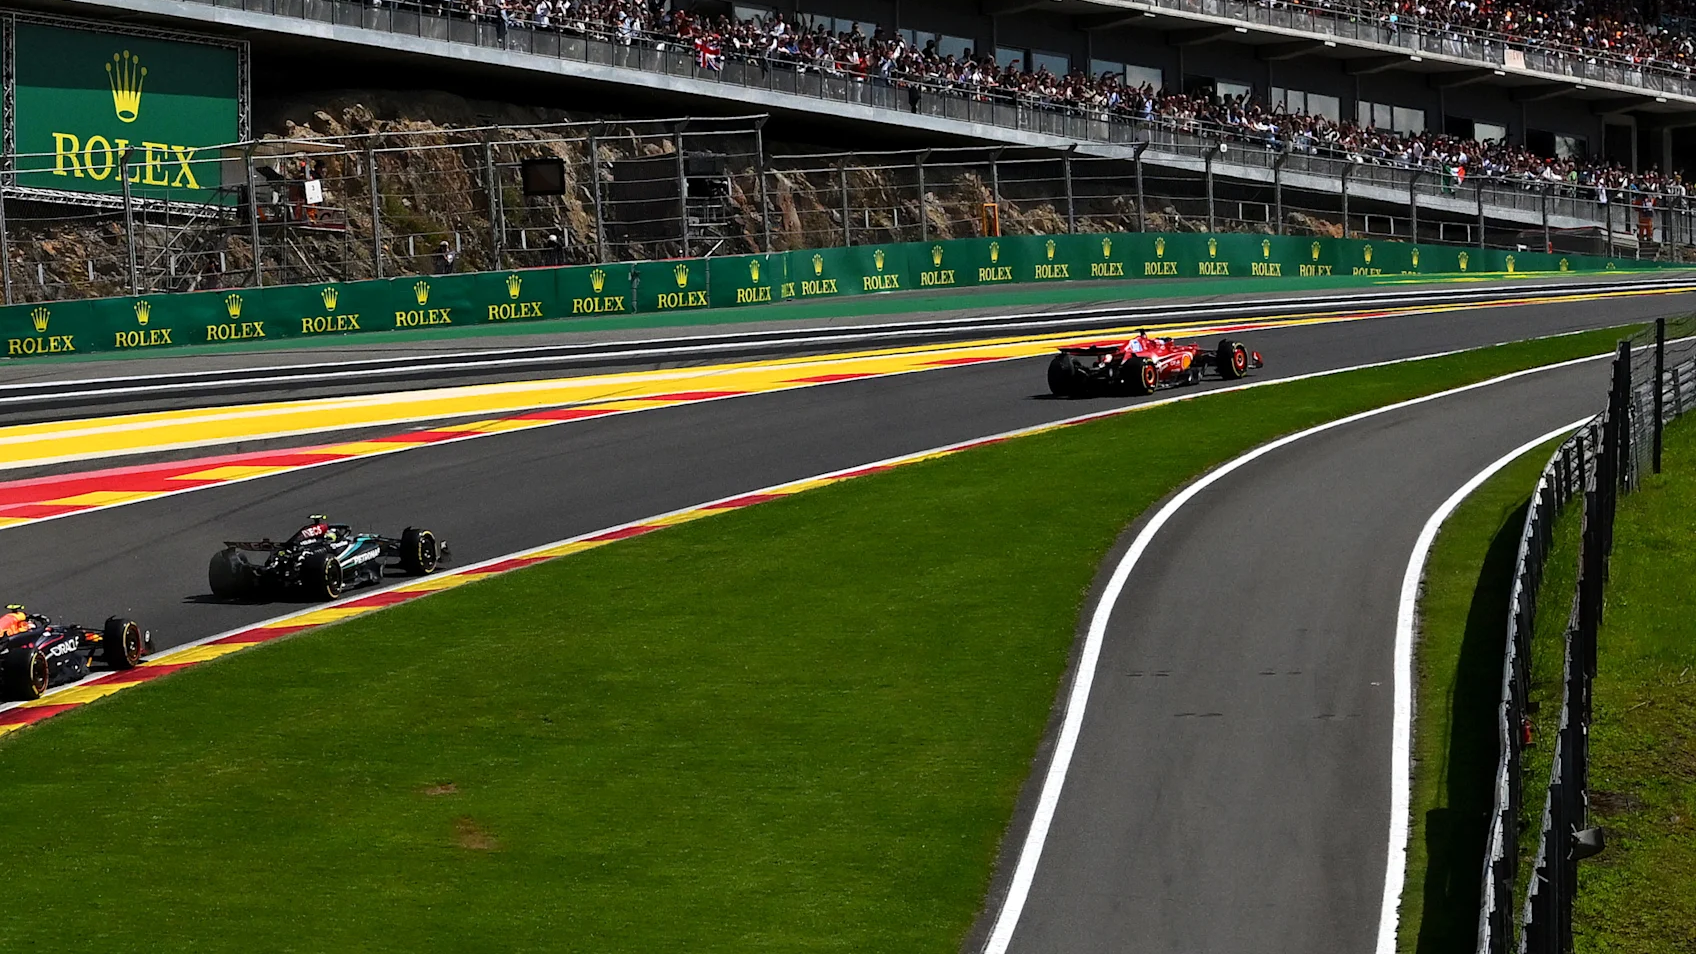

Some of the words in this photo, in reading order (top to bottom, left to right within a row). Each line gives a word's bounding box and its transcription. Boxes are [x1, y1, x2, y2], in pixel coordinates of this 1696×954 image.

[51, 131, 201, 190] ROLEX
[979, 267, 1012, 281] ROLEX
[1035, 264, 1069, 278] ROLEX
[1091, 263, 1123, 276] ROLEX
[1145, 262, 1177, 275] ROLEX
[1199, 262, 1229, 275] ROLEX
[1252, 262, 1281, 276] ROLEX
[1300, 265, 1332, 276] ROLEX
[863, 275, 899, 290] ROLEX
[921, 270, 954, 285] ROLEX
[737, 286, 771, 303] ROLEX
[802, 279, 837, 295] ROLEX
[573, 296, 624, 313] ROLEX
[658, 291, 707, 308] ROLEX
[395, 309, 451, 326] ROLEX
[488, 302, 542, 320] ROLEX
[207, 322, 265, 340] ROLEX
[302, 314, 360, 333] ROLEX
[8, 336, 75, 354] ROLEX
[115, 329, 172, 347] ROLEX
[302, 525, 322, 538] INEOS
